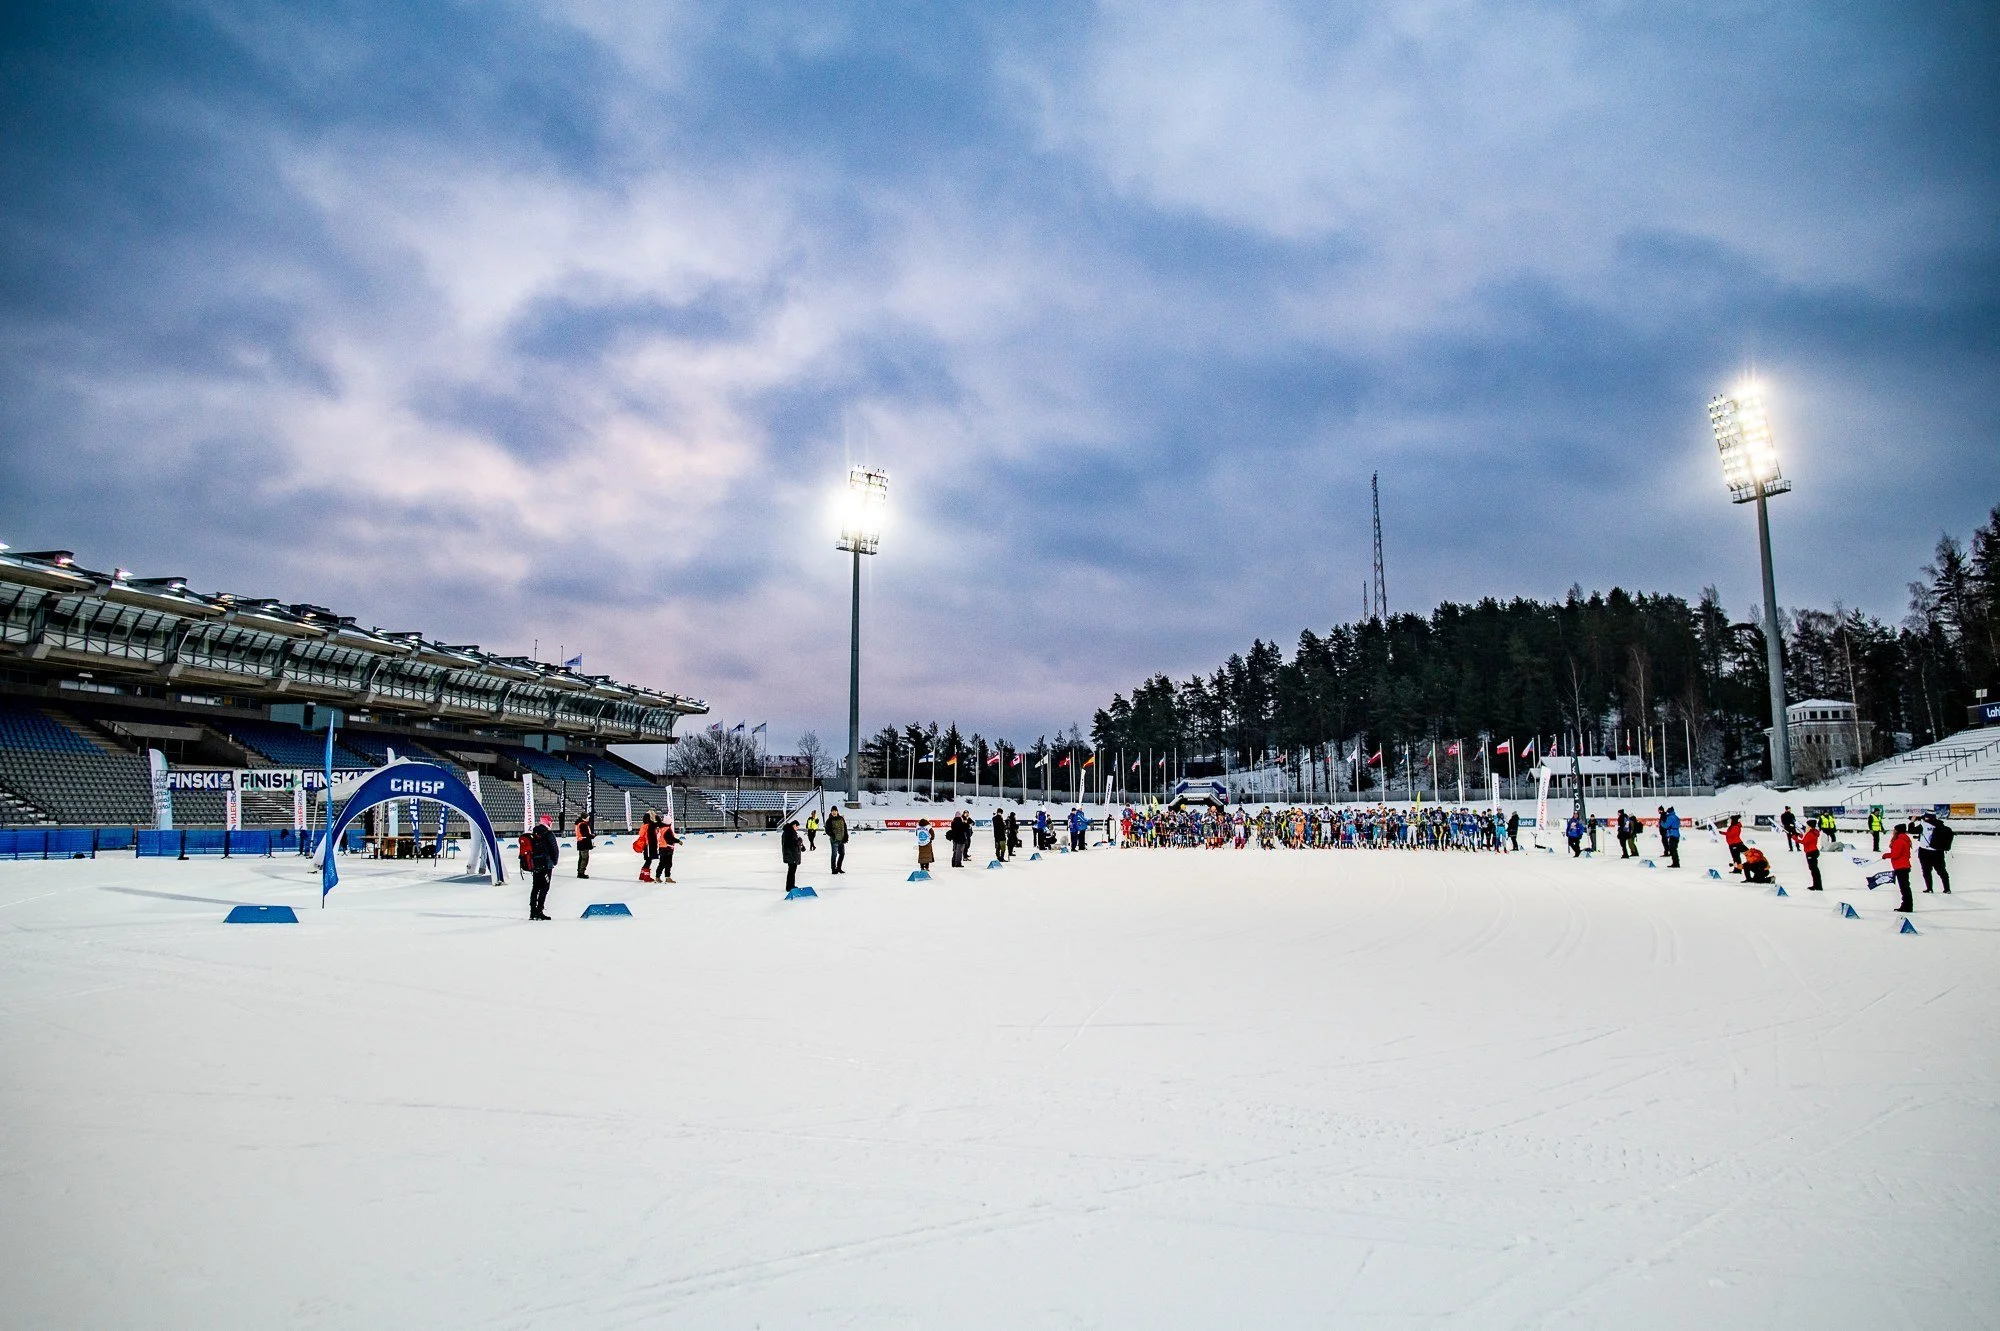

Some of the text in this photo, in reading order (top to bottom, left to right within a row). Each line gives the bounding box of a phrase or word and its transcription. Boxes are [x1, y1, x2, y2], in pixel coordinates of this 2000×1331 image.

[1986, 706, 2000, 718] Lah
[166, 772, 219, 789] FINSKI
[240, 773, 294, 788] FINISH
[390, 778, 445, 795] CRISP
